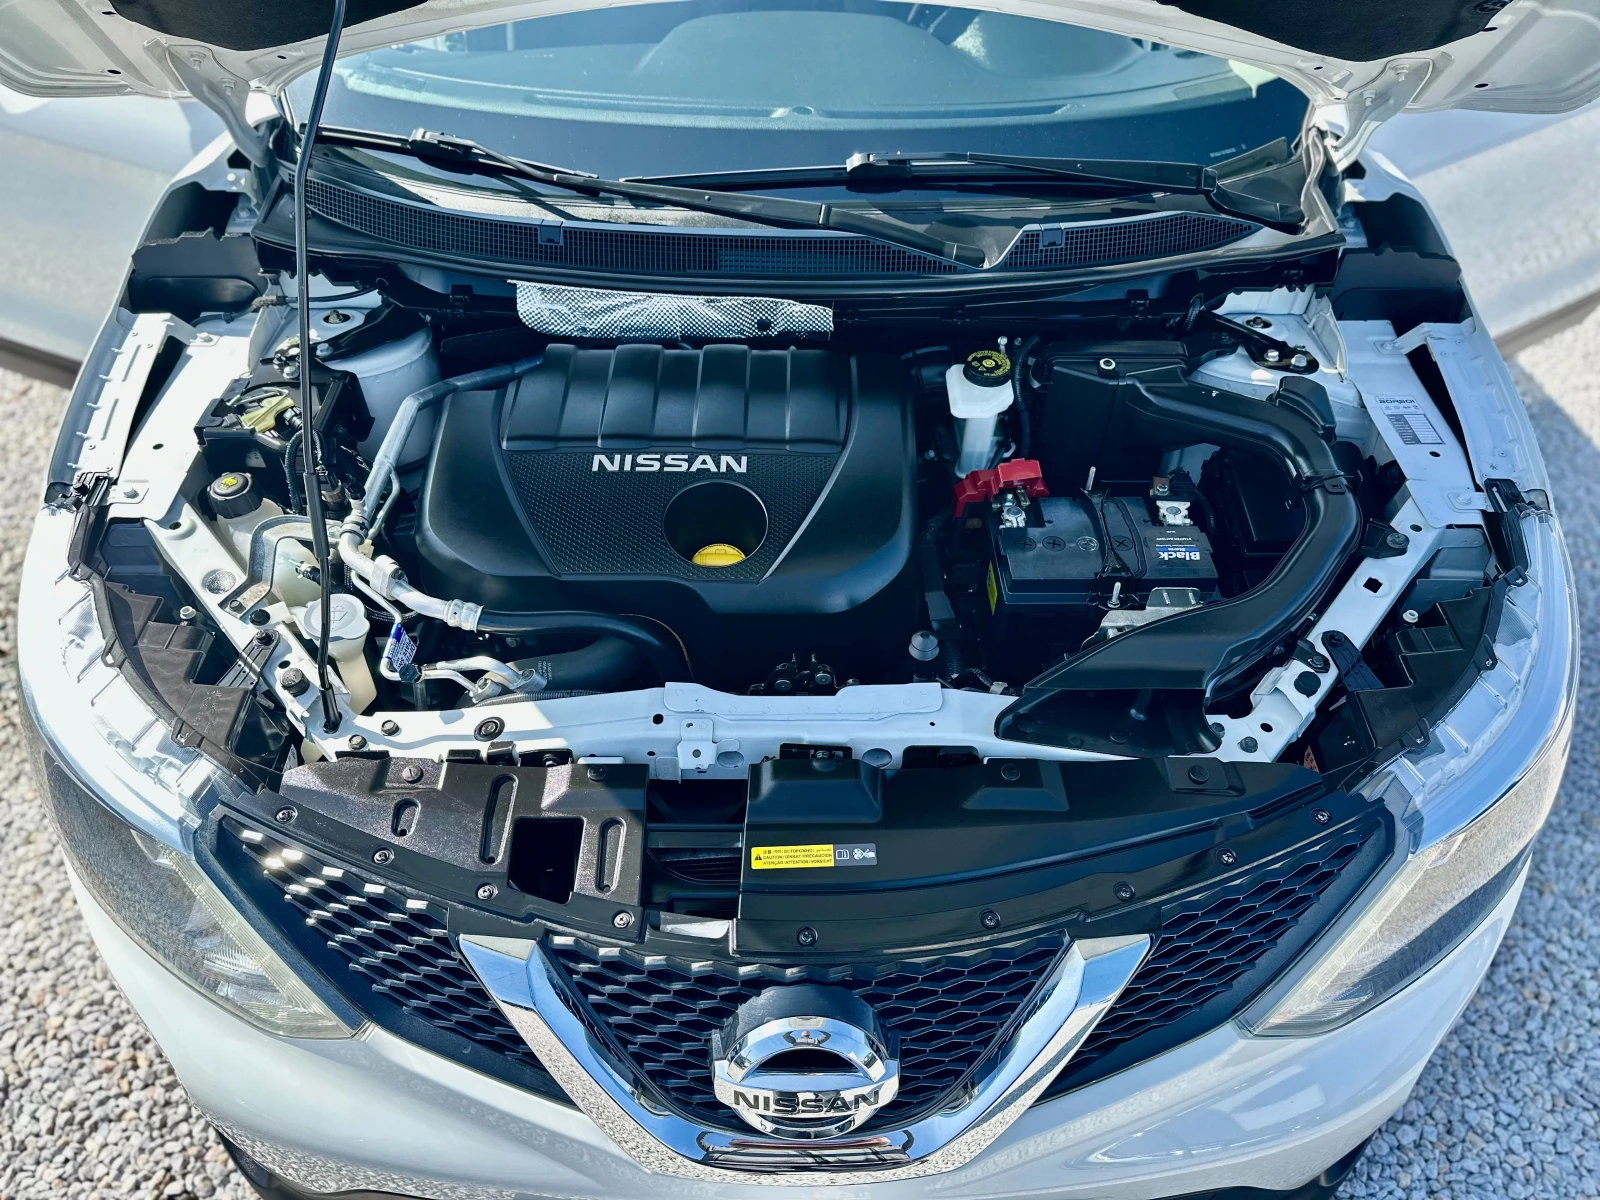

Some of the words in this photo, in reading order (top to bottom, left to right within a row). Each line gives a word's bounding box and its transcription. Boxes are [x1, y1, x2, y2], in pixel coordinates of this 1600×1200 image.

[591, 454, 748, 473] NISSAN
[1158, 551, 1201, 561] Black
[733, 1089, 880, 1114] NISSAN
